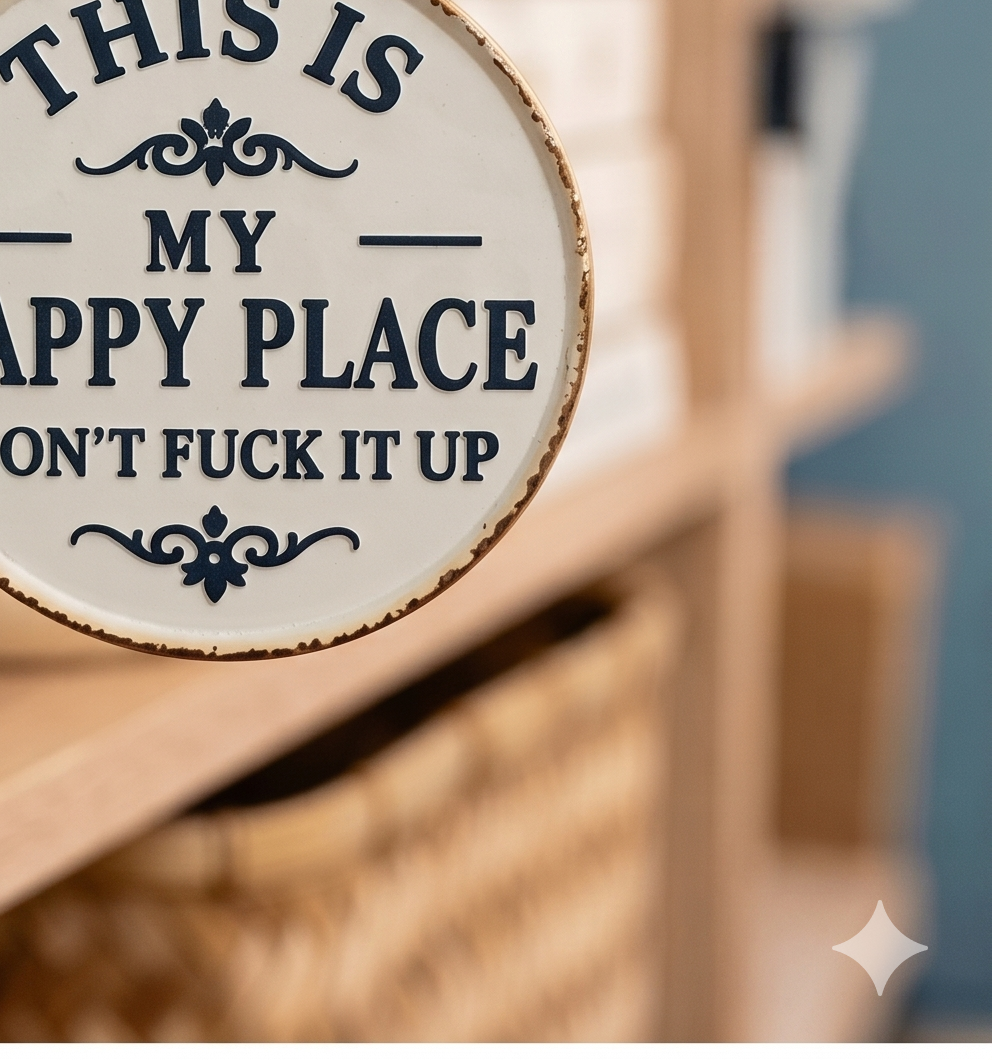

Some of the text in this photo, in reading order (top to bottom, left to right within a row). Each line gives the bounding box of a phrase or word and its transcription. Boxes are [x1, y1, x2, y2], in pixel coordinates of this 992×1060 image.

[302, 0, 425, 114] IS
[145, 210, 276, 272] MY
[241, 298, 538, 391] PLACE
[162, 429, 324, 480] FUCK
[341, 430, 400, 480] IT
[416, 431, 499, 481] UP
